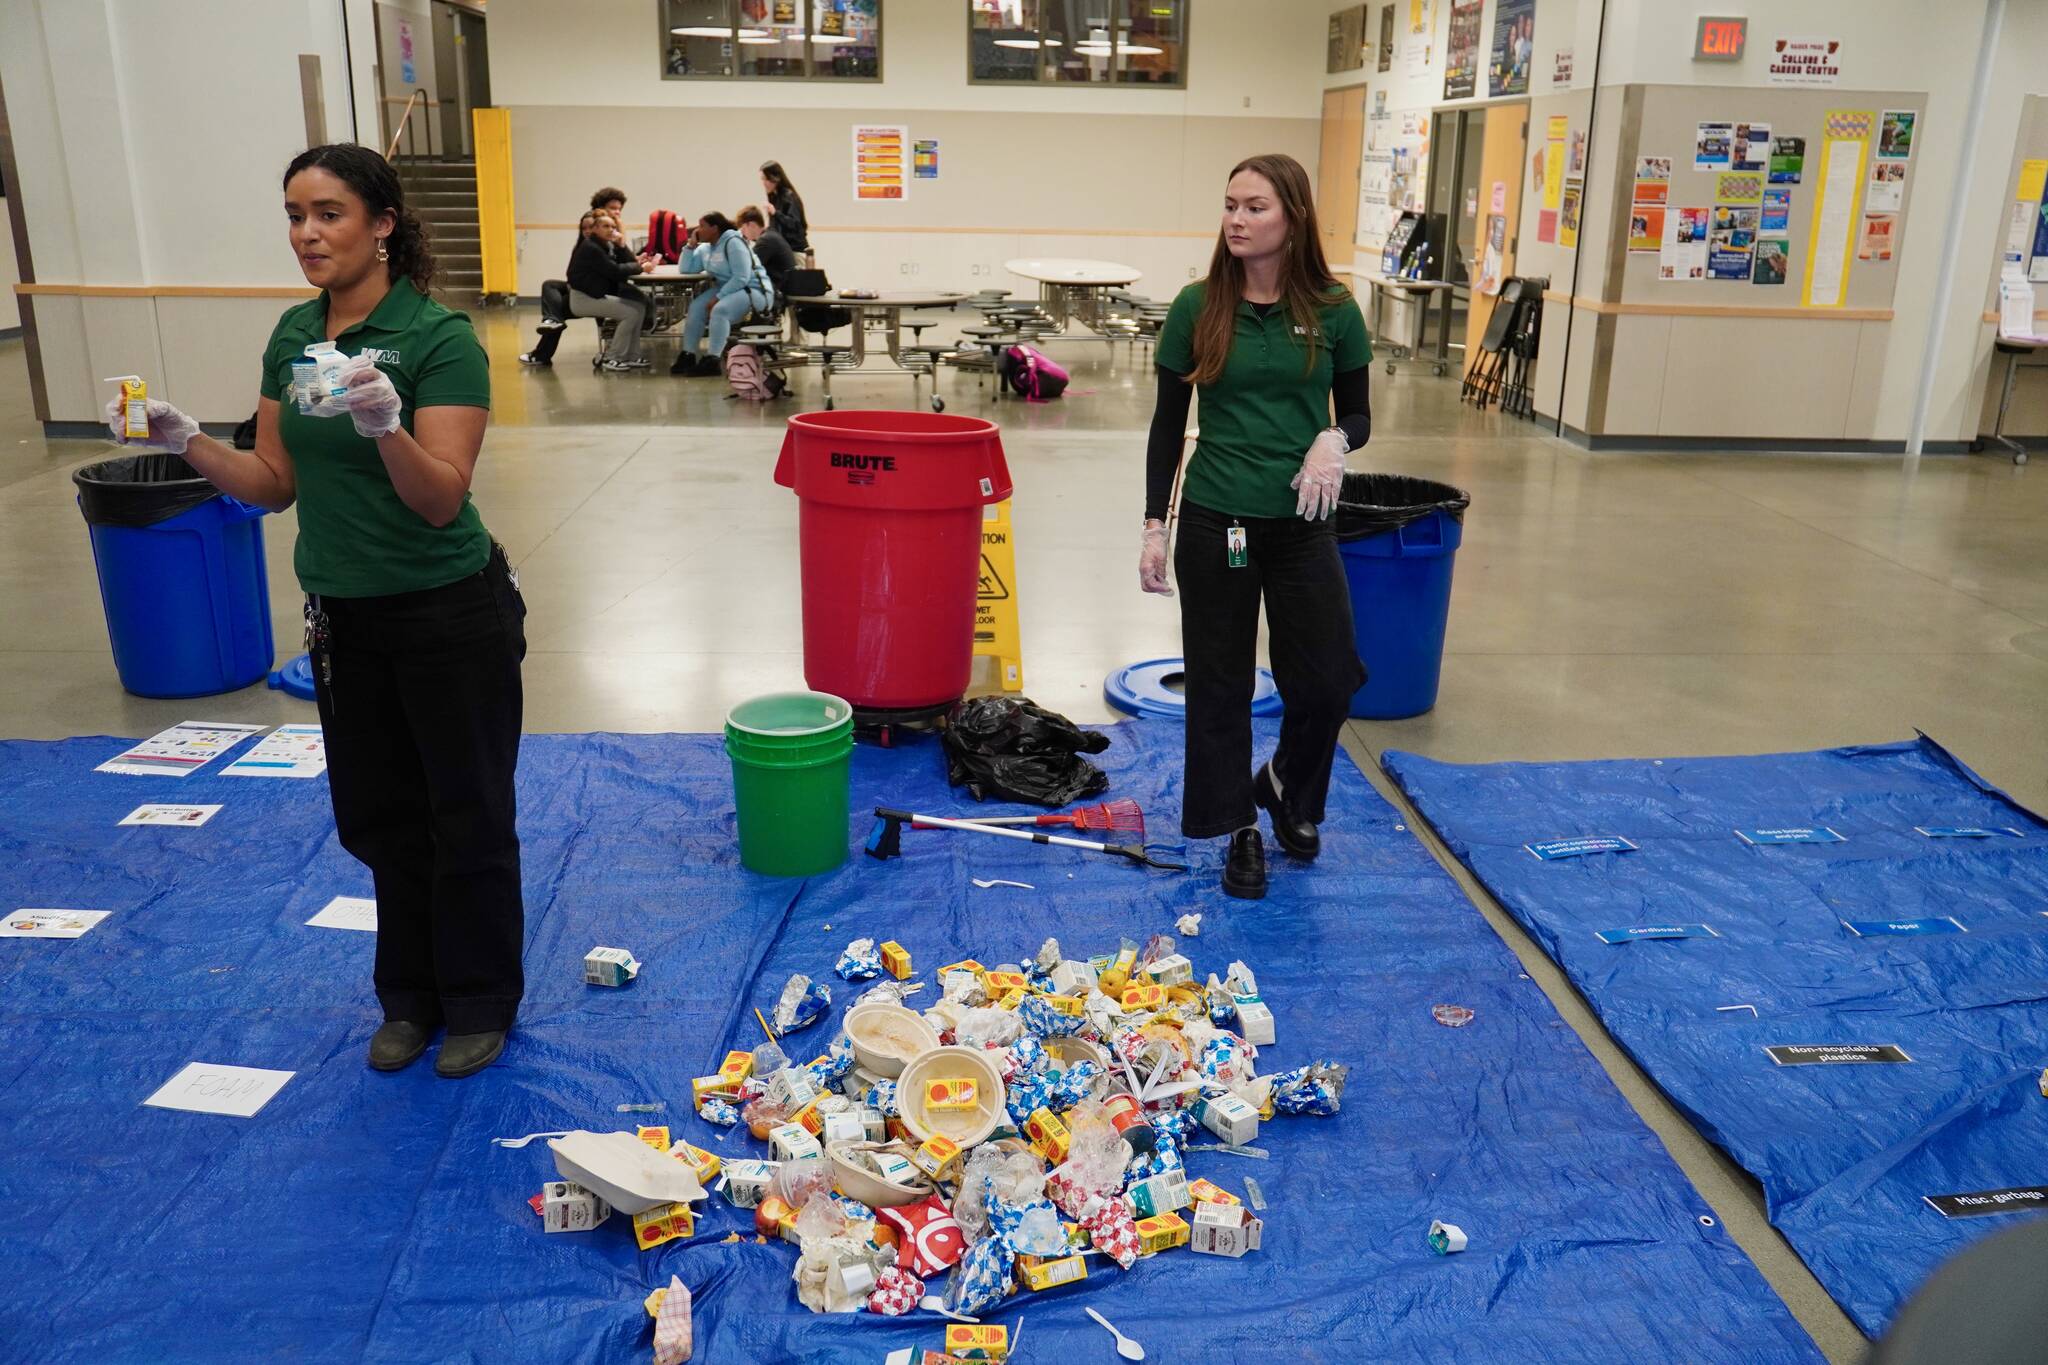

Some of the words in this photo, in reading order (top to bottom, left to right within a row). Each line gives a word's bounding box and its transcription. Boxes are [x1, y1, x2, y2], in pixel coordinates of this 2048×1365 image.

[1703, 22, 1742, 55] EXIT
[1806, 65, 1838, 75] CENTER
[361, 347, 400, 363] WM
[831, 452, 896, 471] BRUTE
[982, 533, 1006, 544] TION
[976, 616, 996, 624] OOR
[1788, 1045, 1880, 1054] Non-recyclable
[1818, 1053, 1867, 1062] plastics
[184, 1074, 264, 1102] FOAM
[1954, 1196, 1994, 1206] Misc.
[1993, 1191, 2045, 1204] garbage
